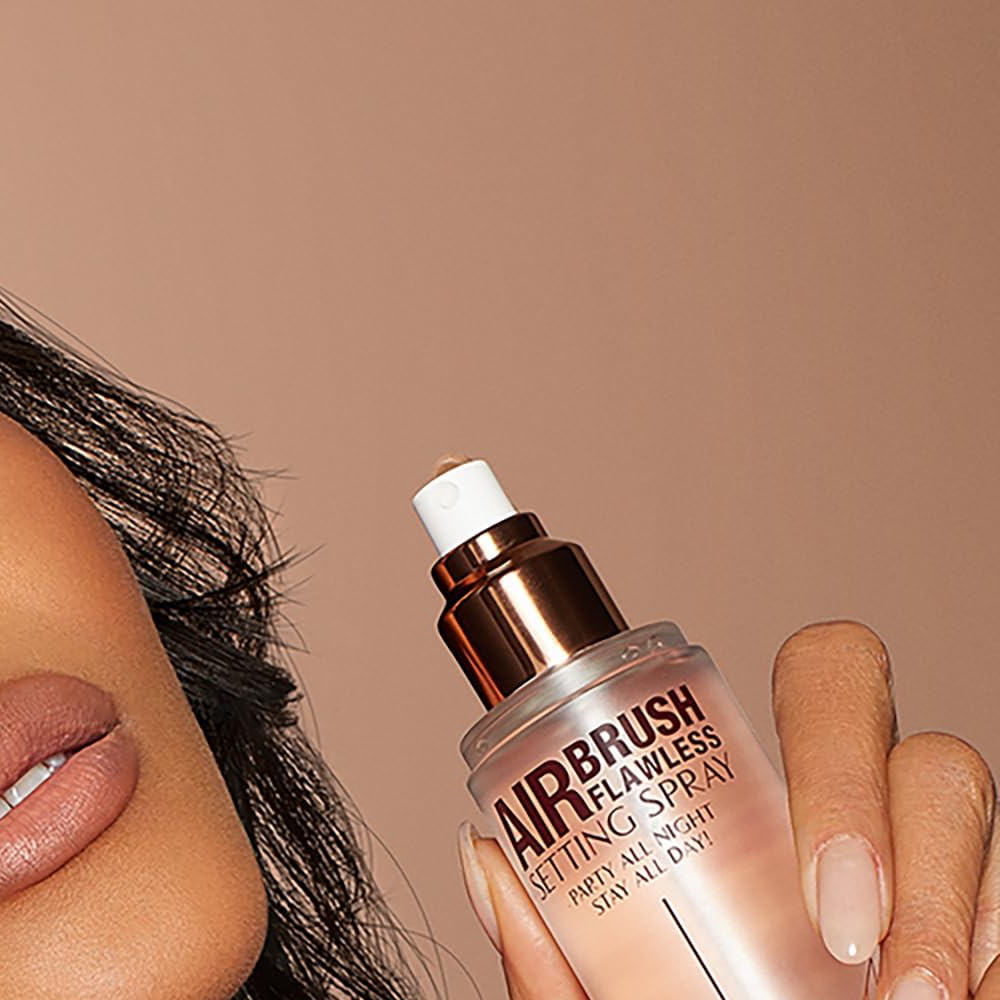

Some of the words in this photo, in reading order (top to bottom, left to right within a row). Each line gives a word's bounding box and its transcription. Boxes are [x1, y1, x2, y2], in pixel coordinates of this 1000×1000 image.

[494, 760, 594, 871] AIR
[562, 684, 706, 785] BRUSH
[587, 725, 722, 810] FLAWLESS
[530, 805, 637, 900] SETTING
[639, 751, 735, 817] SPRAY
[568, 862, 615, 907] PARTY
[621, 841, 653, 870] ALL
[653, 802, 715, 846] NIGHT
[591, 879, 630, 916] STAY
[634, 859, 668, 887] ALL
[667, 830, 714, 865] DAY!
